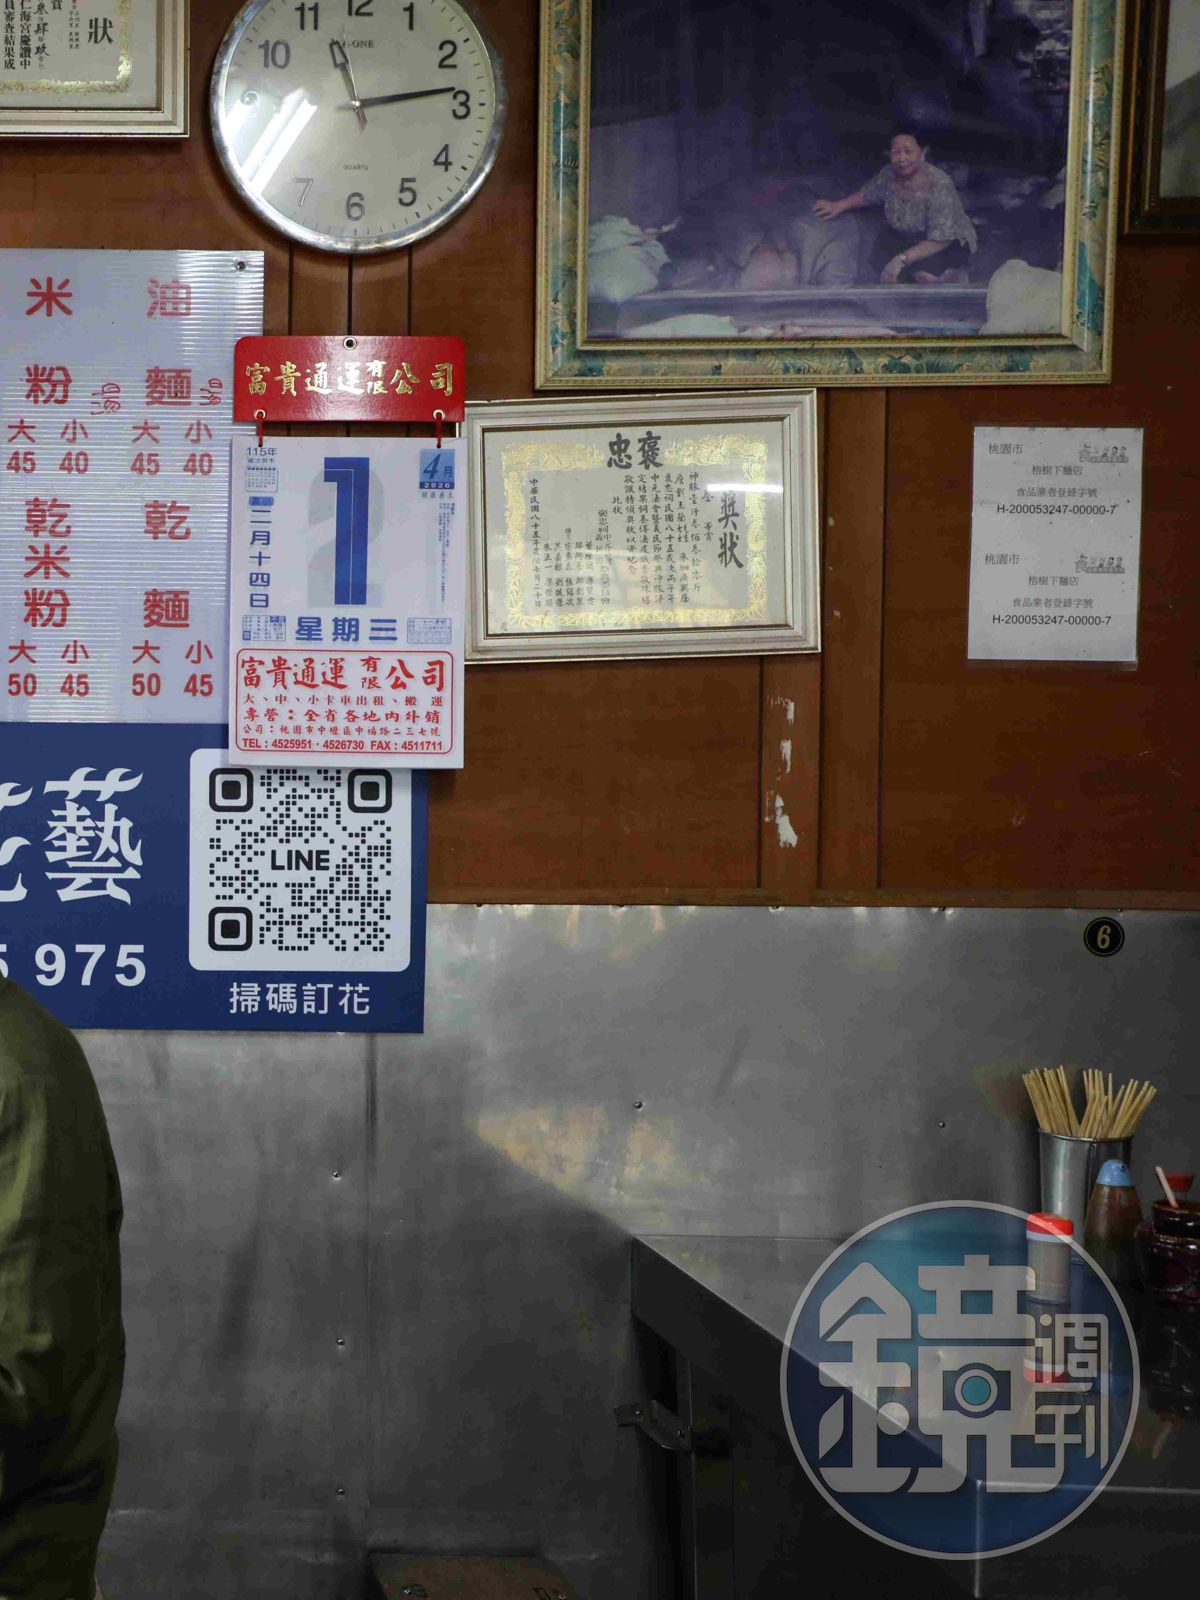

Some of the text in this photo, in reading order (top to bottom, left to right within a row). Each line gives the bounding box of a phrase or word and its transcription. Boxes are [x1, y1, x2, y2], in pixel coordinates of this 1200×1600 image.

[87, 17, 114, 44] 狀
[295, 5, 318, 31] 11
[403, 5, 414, 31] 1
[258, 39, 291, 69] 10
[438, 40, 457, 69] 2
[452, 89, 471, 120] 3
[433, 144, 453, 172] 4
[295, 178, 417, 221] 7 6 5
[24, 276, 73, 405] 米粉
[145, 276, 192, 406] 油麵
[246, 359, 454, 397] 富貴通運有限公司
[8, 418, 89, 444] 大 小
[132, 419, 213, 445] 大 小
[6, 450, 89, 474] 45 40
[246, 447, 278, 457] 115年
[988, 443, 1024, 456] 桃園市
[130, 451, 213, 476] 45 40
[996, 504, 1117, 515] H-200053247-00000-7
[324, 457, 370, 605] 1
[717, 491, 745, 569] 獎狀
[23, 496, 72, 628] 乾米粉
[143, 500, 192, 628] 乾麵
[249, 509, 272, 608] 二月十四日
[985, 553, 1020, 566] 桃園市
[295, 616, 398, 642] 星期三
[992, 615, 1112, 626] H-200053247-00000-7
[8, 639, 90, 664] 大 小
[132, 639, 213, 665] 大 小
[7, 673, 90, 697] 50 45
[131, 673, 214, 697] 50 45
[241, 655, 446, 693] 富貴通運有限公司
[401, 741, 443, 751] 4511711
[271, 850, 331, 871] LINE
[1097, 924, 1112, 949] 6
[229, 982, 371, 1016] 掃碼訂花
